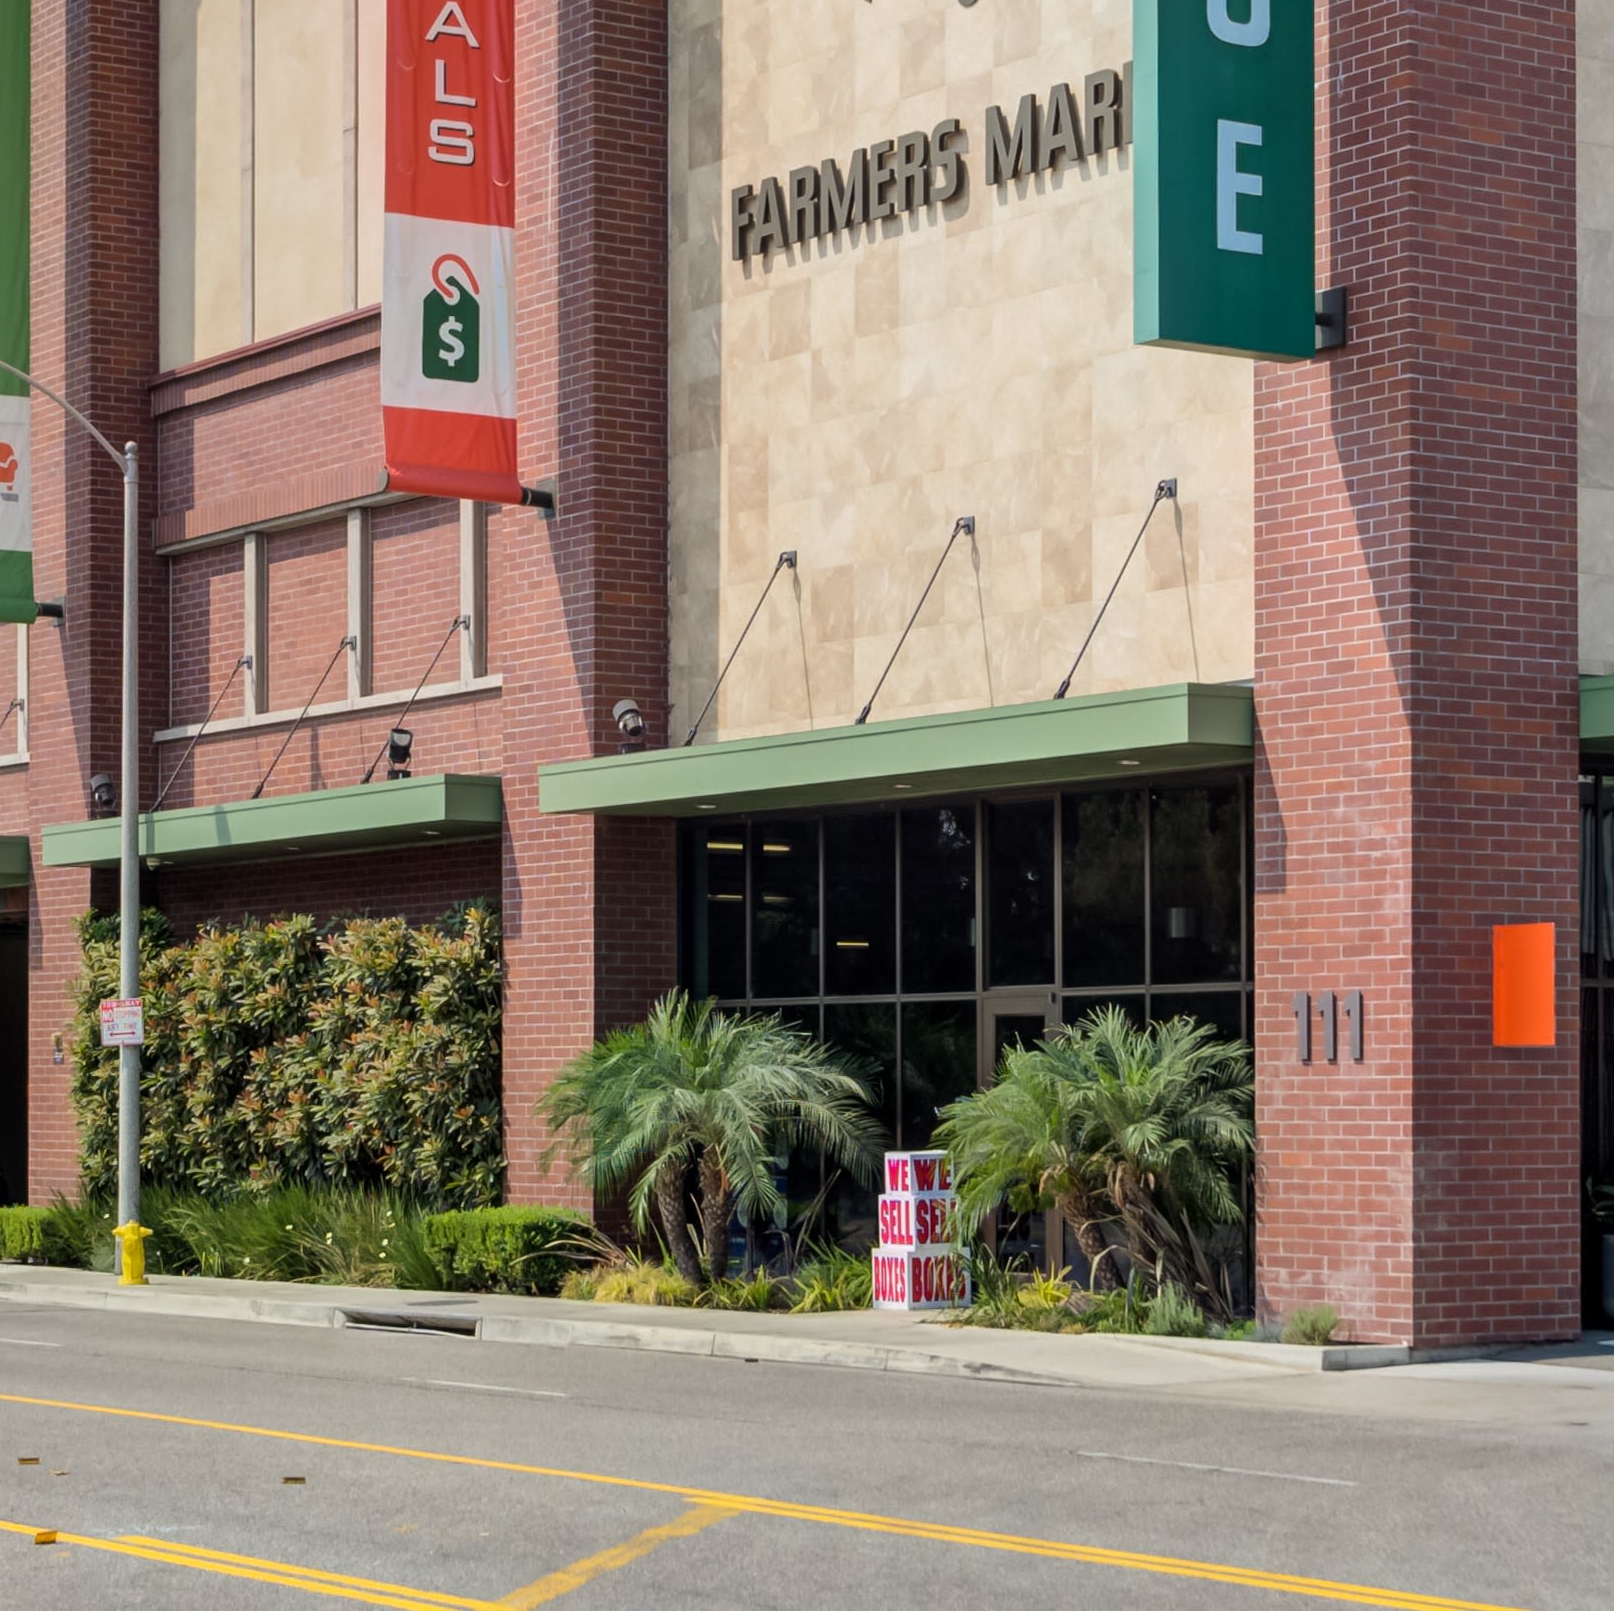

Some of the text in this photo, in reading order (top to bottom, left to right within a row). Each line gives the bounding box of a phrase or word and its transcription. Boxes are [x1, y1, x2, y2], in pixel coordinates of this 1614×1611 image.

[731, 60, 1134, 261] FARMERS MAR
[1292, 989, 1364, 1065] 111
[887, 1159, 909, 1192] WE
[914, 1159, 952, 1191] WE
[880, 1200, 913, 1245] SELL
[874, 1256, 906, 1302] BOXES
